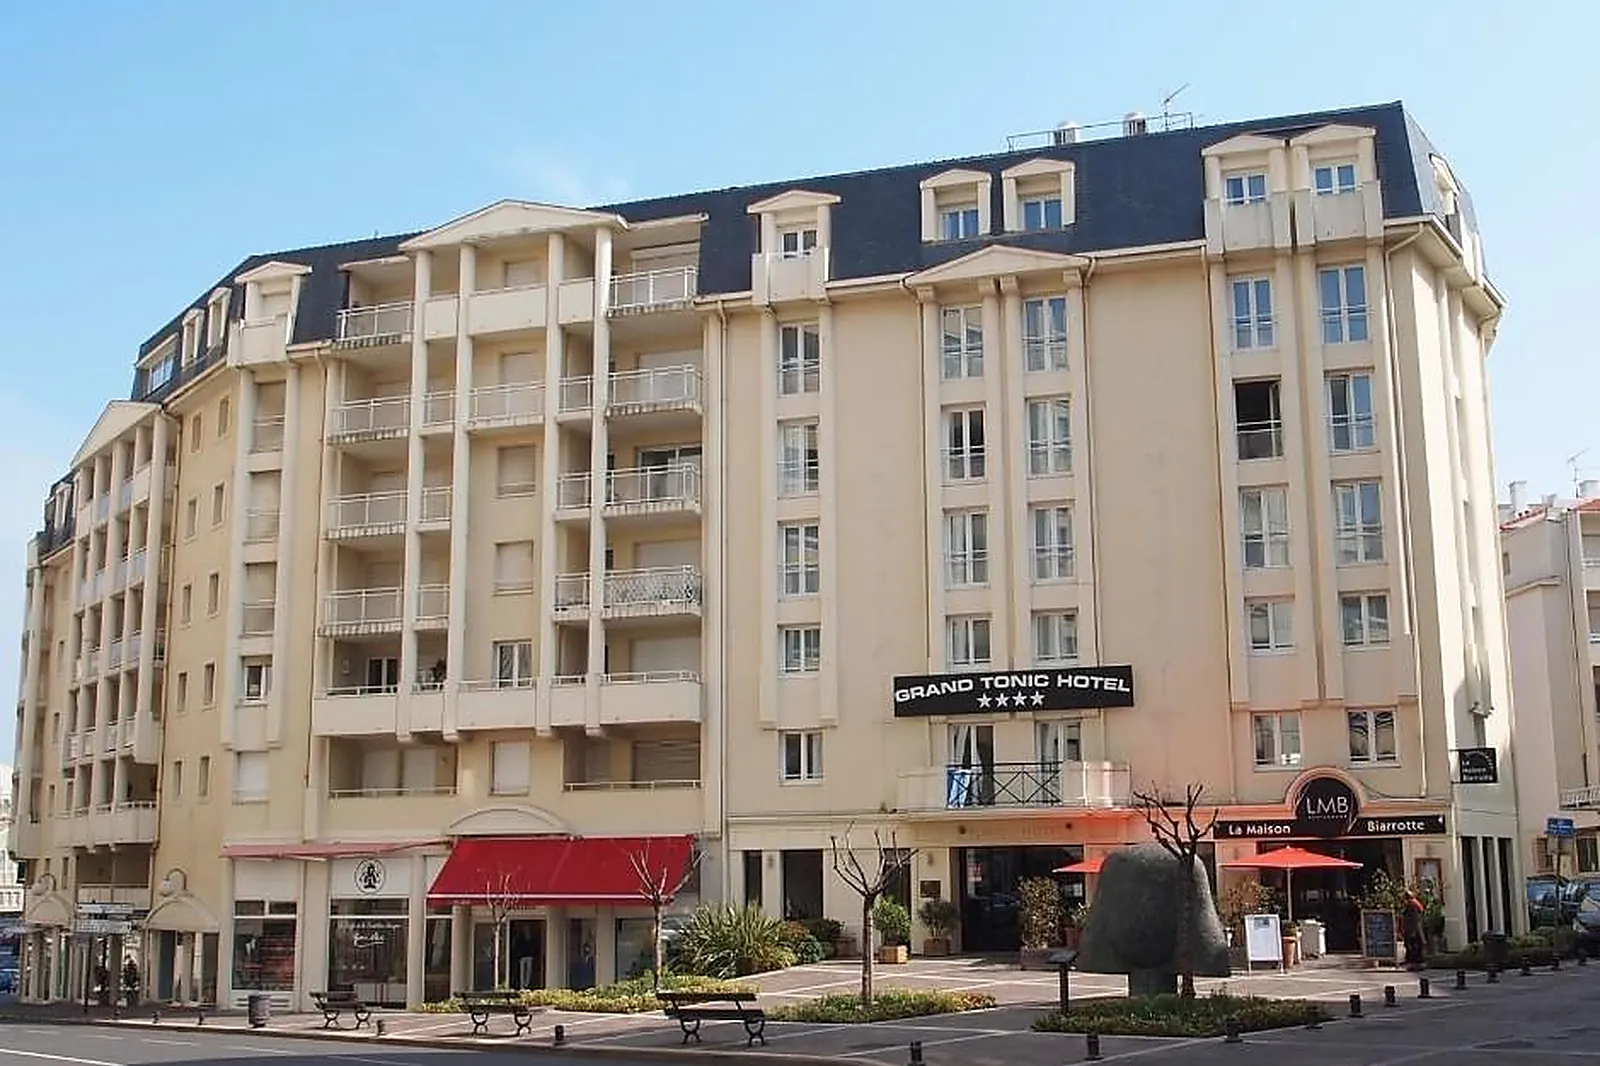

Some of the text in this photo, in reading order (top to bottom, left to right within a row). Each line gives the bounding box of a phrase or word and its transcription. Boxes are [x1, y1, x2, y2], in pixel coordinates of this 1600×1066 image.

[895, 673, 1131, 702] GRAND TONIC HOTEL
[1306, 797, 1349, 815] LMB
[1228, 824, 1291, 836] La Maison
[1367, 819, 1425, 832] Biarrotte
